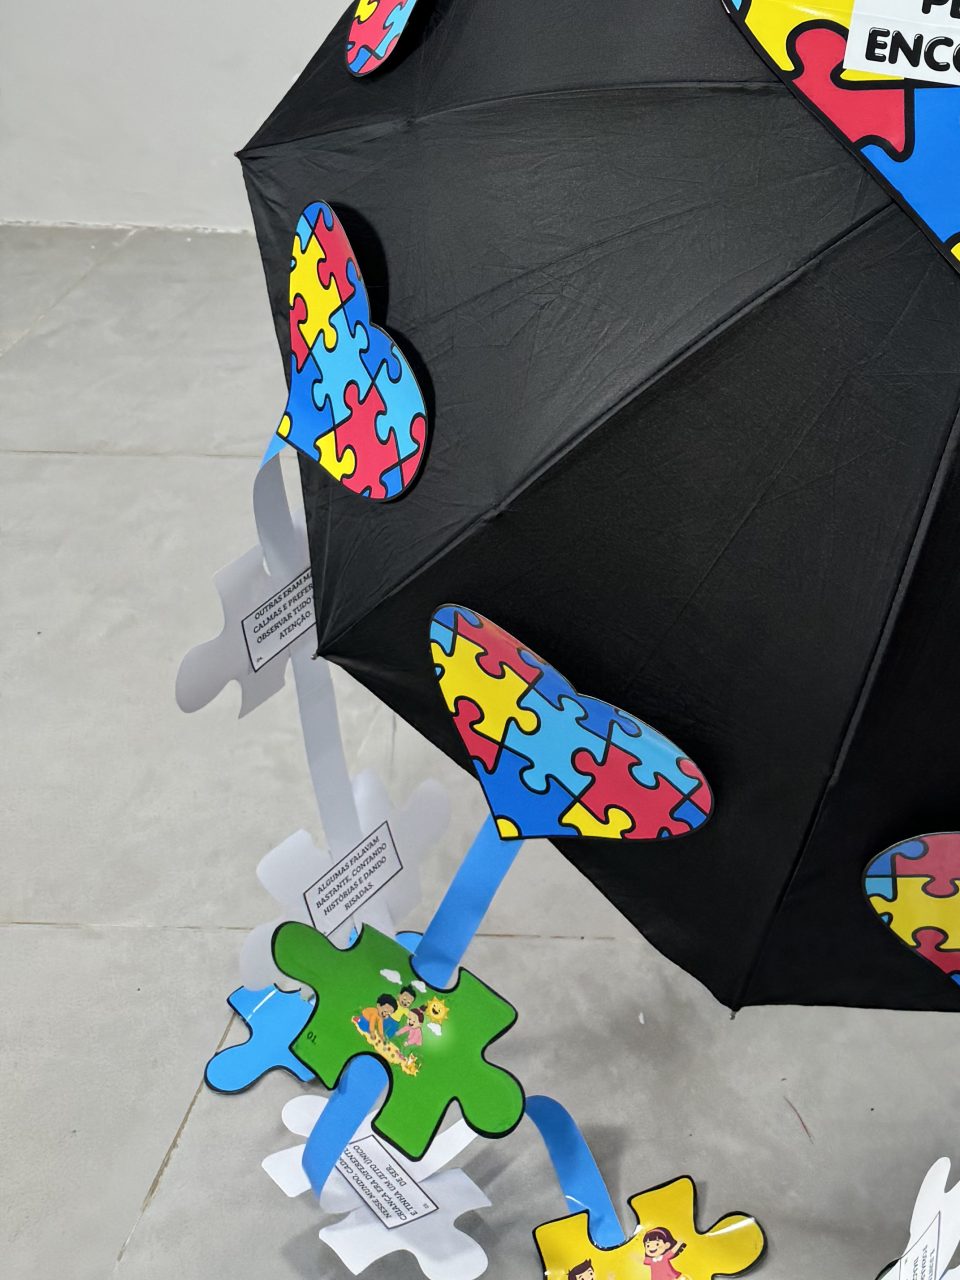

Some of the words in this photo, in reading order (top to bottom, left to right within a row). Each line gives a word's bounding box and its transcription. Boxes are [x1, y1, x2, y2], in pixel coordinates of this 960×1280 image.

[253, 607, 282, 634] CALMAS
[288, 583, 313, 607] PREFER
[254, 594, 282, 620] OUTRAS
[256, 612, 293, 644] OBSERVAR
[293, 597, 312, 616] TUDO
[317, 862, 350, 895] ALGUMAS
[350, 835, 380, 866] FALAVAM
[351, 842, 387, 877] CONTANDO
[363, 856, 387, 880] DANDO
[381, 1192, 407, 1221] CRIANÇA
